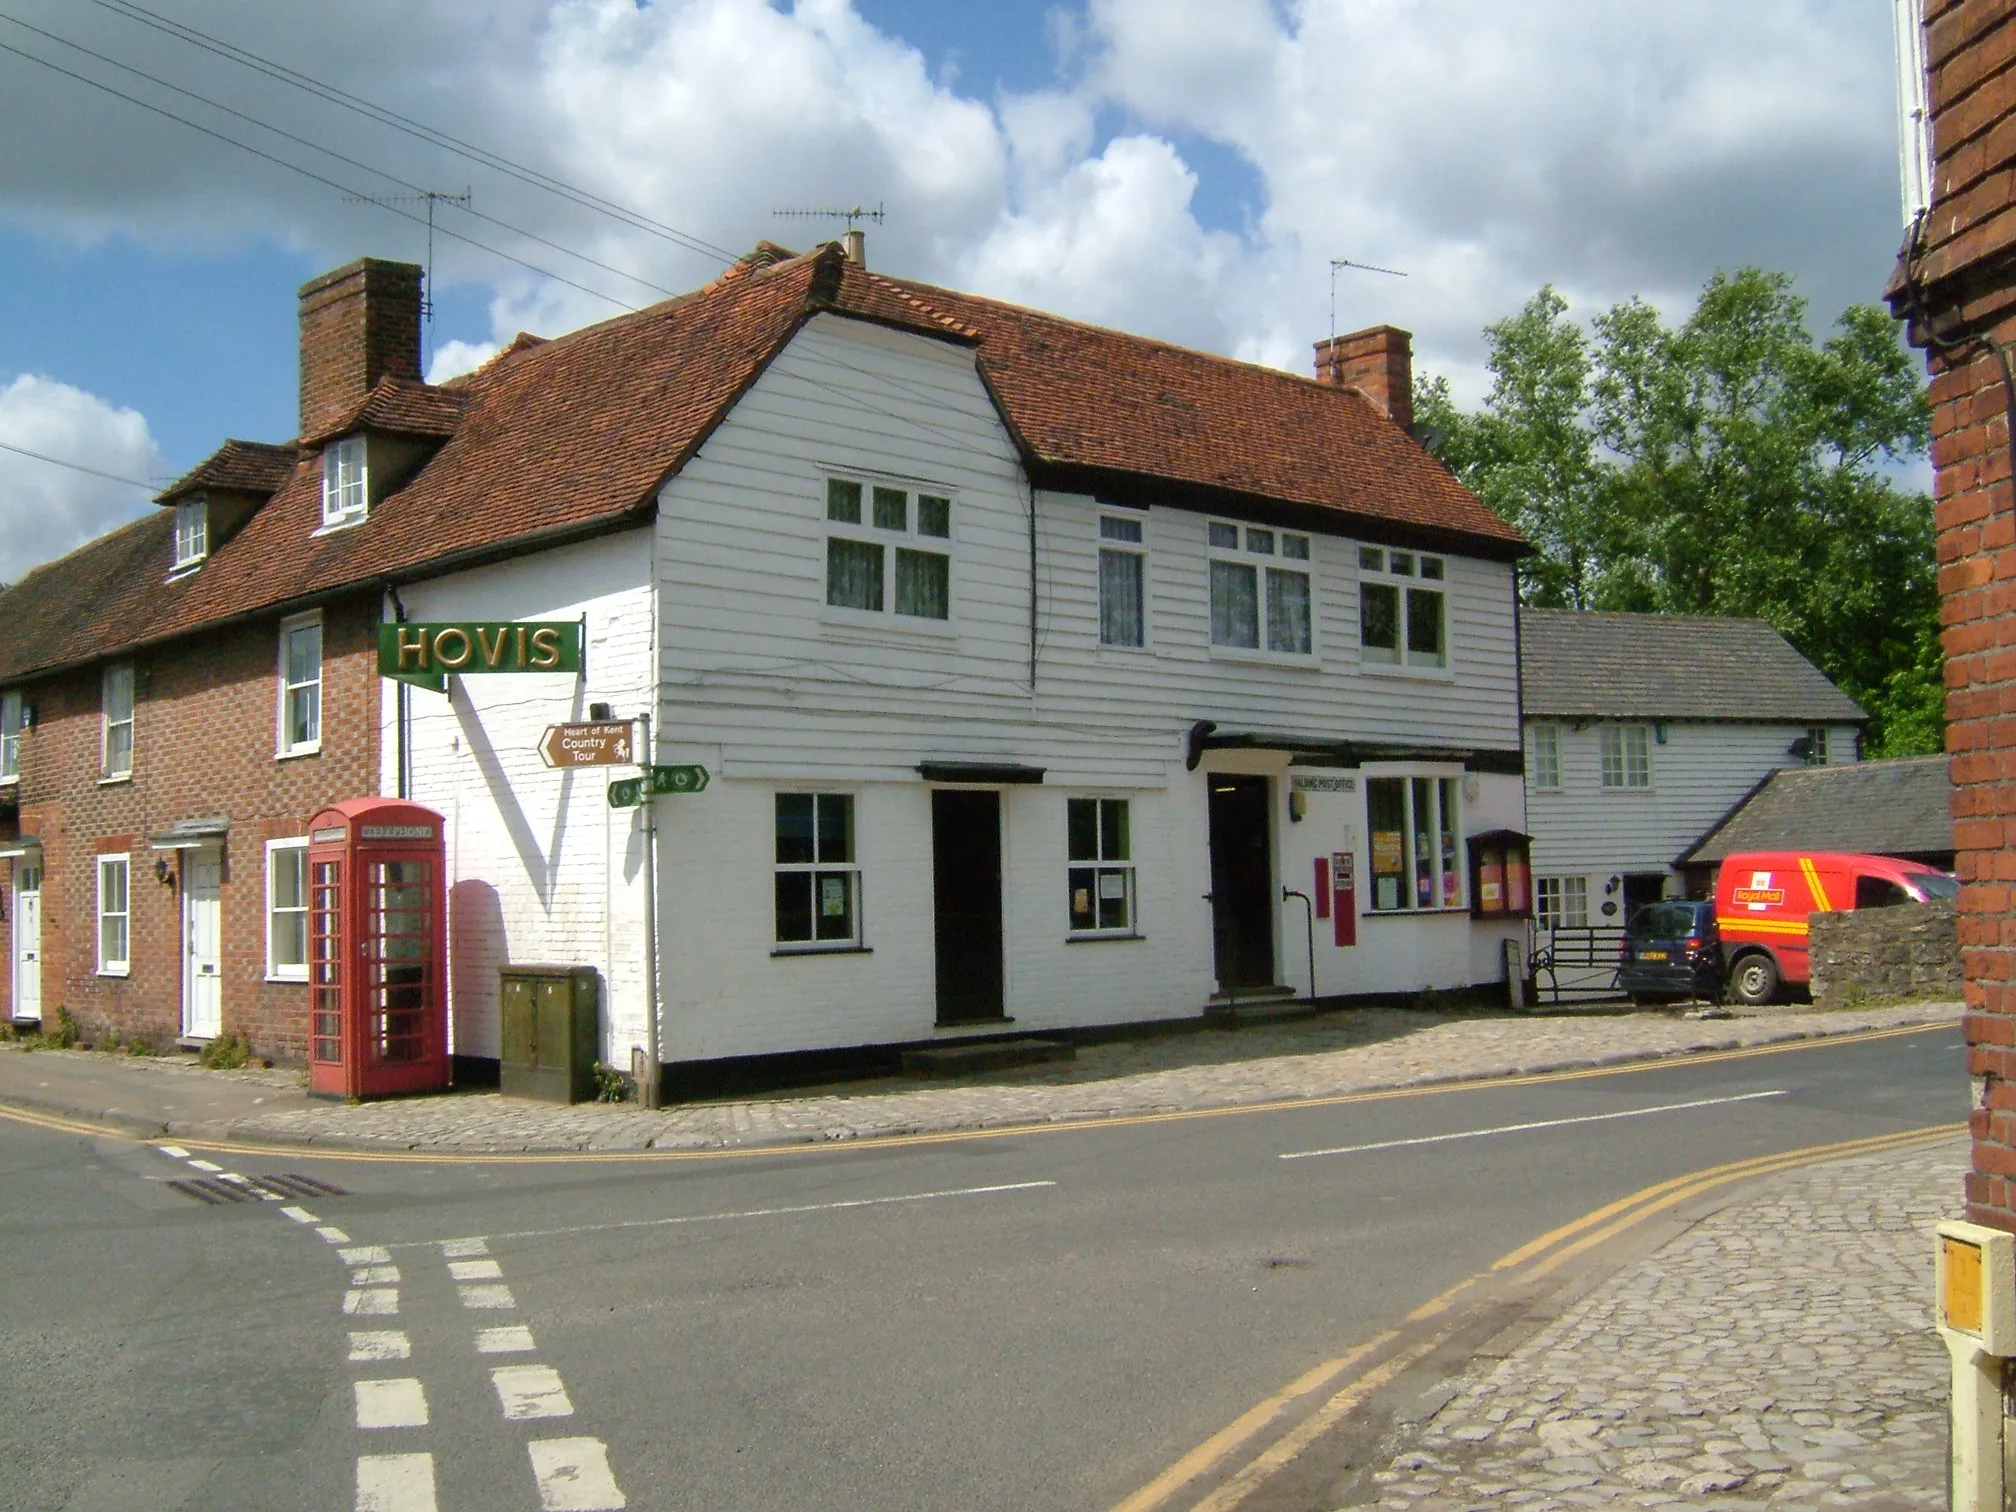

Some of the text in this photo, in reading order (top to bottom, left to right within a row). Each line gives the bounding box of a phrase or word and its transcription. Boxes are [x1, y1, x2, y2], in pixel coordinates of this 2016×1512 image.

[398, 628, 560, 668] HOVIS
[564, 725, 623, 736] Heart of Kent
[562, 738, 606, 749] Country
[573, 750, 596, 761] Tour
[362, 826, 431, 837] TELEPHONE
[1737, 890, 1780, 902] Royal Mail
